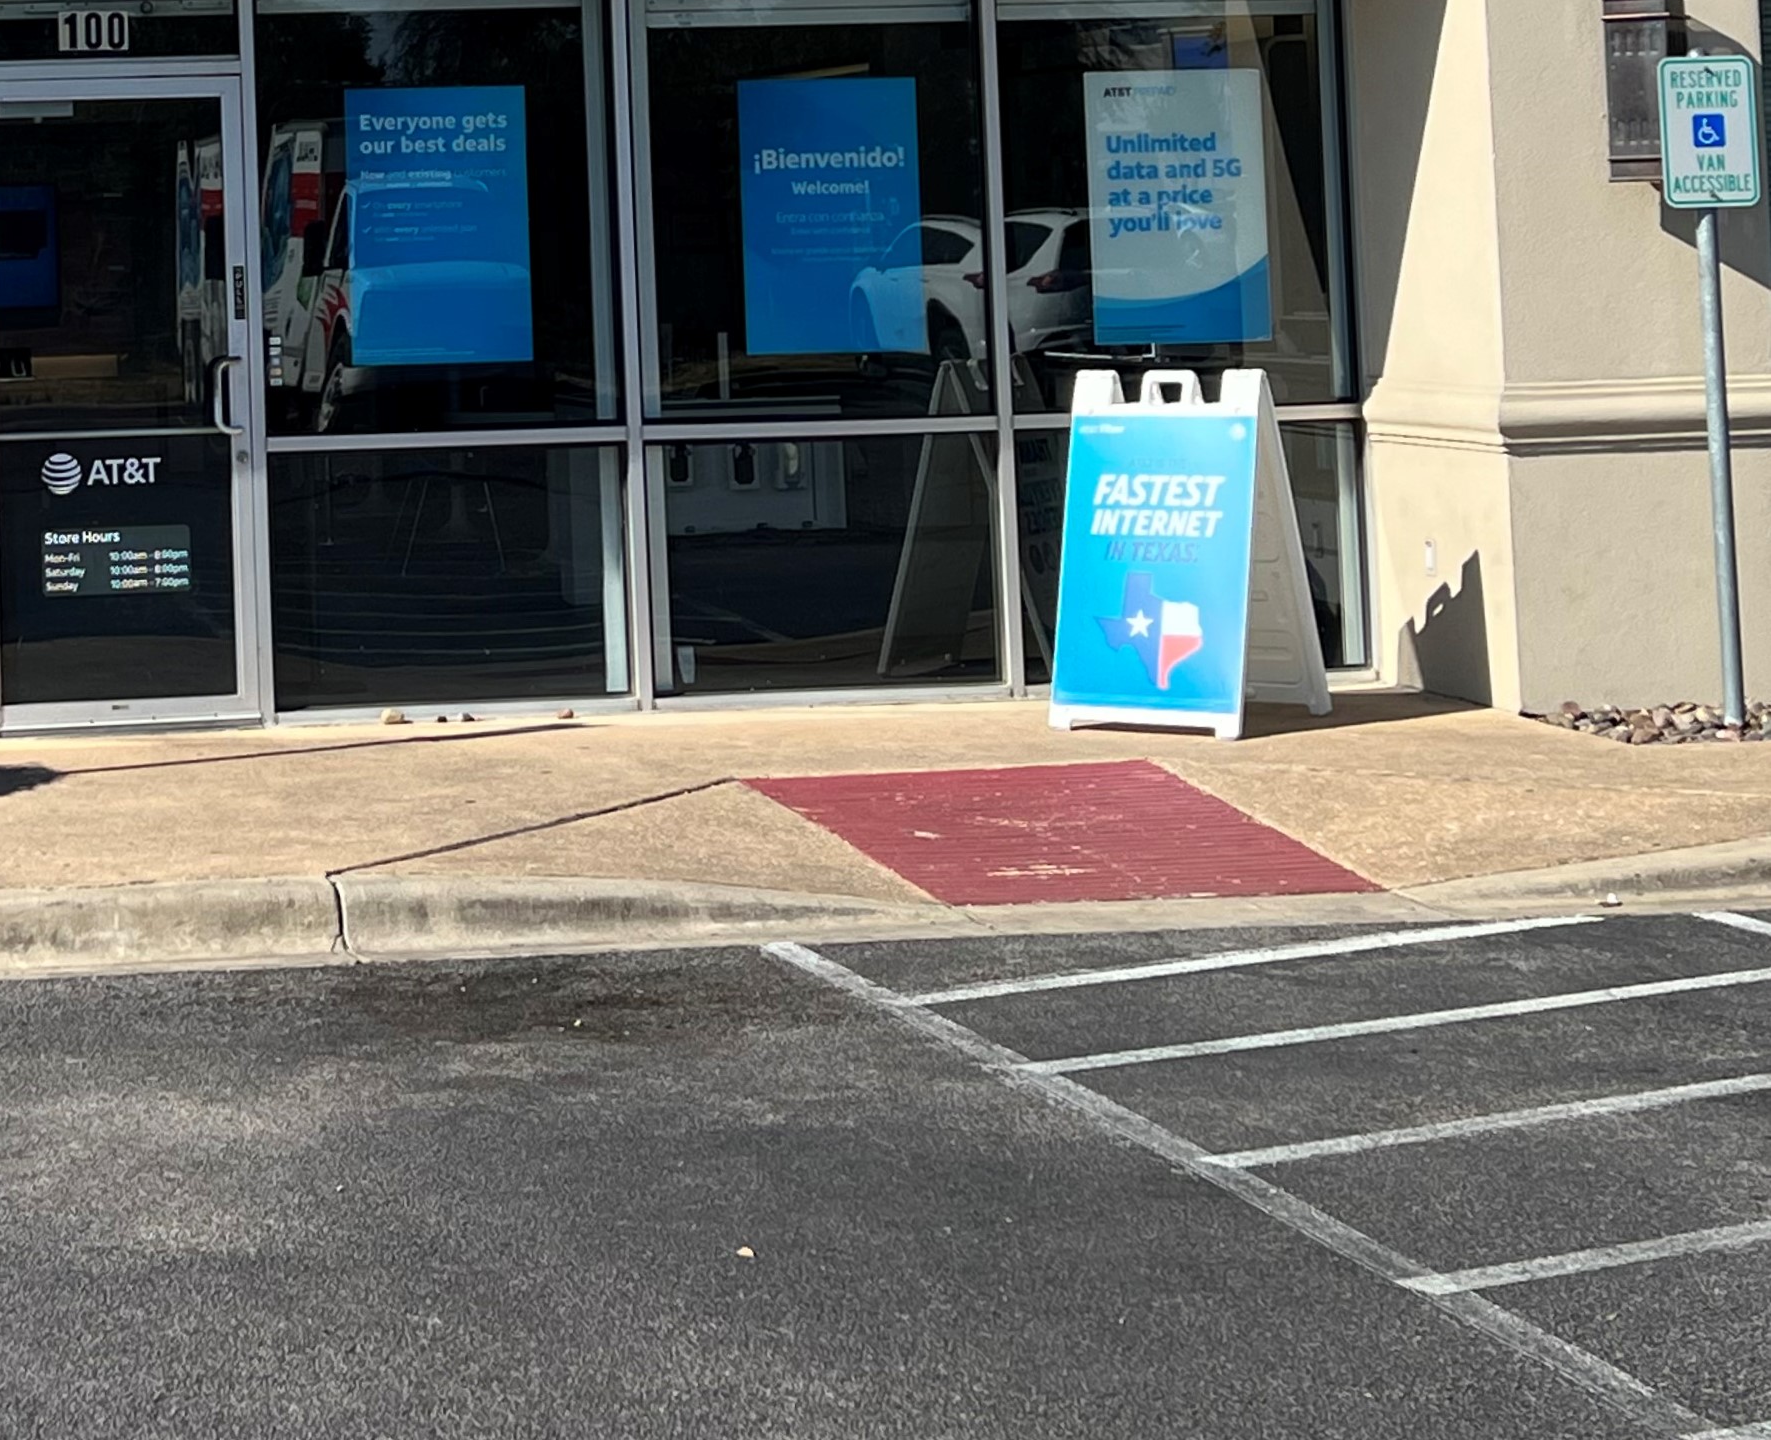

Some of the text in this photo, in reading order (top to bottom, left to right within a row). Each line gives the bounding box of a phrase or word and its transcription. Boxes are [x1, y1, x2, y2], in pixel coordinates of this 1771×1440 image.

[64, 12, 125, 49] 100
[1670, 69, 1742, 89] RESERVED
[1103, 87, 1132, 98] AT&T
[1676, 90, 1738, 109] PARKING
[359, 112, 508, 135] Everyone gets
[359, 134, 506, 155] our best deals
[1106, 131, 1216, 153] Unlimited
[753, 145, 905, 175] ¡Bienvenido!
[1107, 158, 1242, 180] data and 5G
[1697, 154, 1726, 172] VAN
[407, 168, 452, 181] existing
[1673, 174, 1752, 193] ACCESSIBLE
[791, 180, 869, 195] Welcome!
[1108, 184, 1213, 211] at a price
[1176, 210, 1223, 231] love
[87, 457, 162, 486] AT&T
[1093, 473, 1226, 507] FASTEST
[1090, 509, 1223, 538] INTERNET
[44, 530, 121, 545] Store Hours
[44, 552, 81, 564] Mon-Fri
[1104, 541, 1126, 561] IN
[45, 566, 86, 579] Saturday
[45, 580, 79, 593] Sunday
